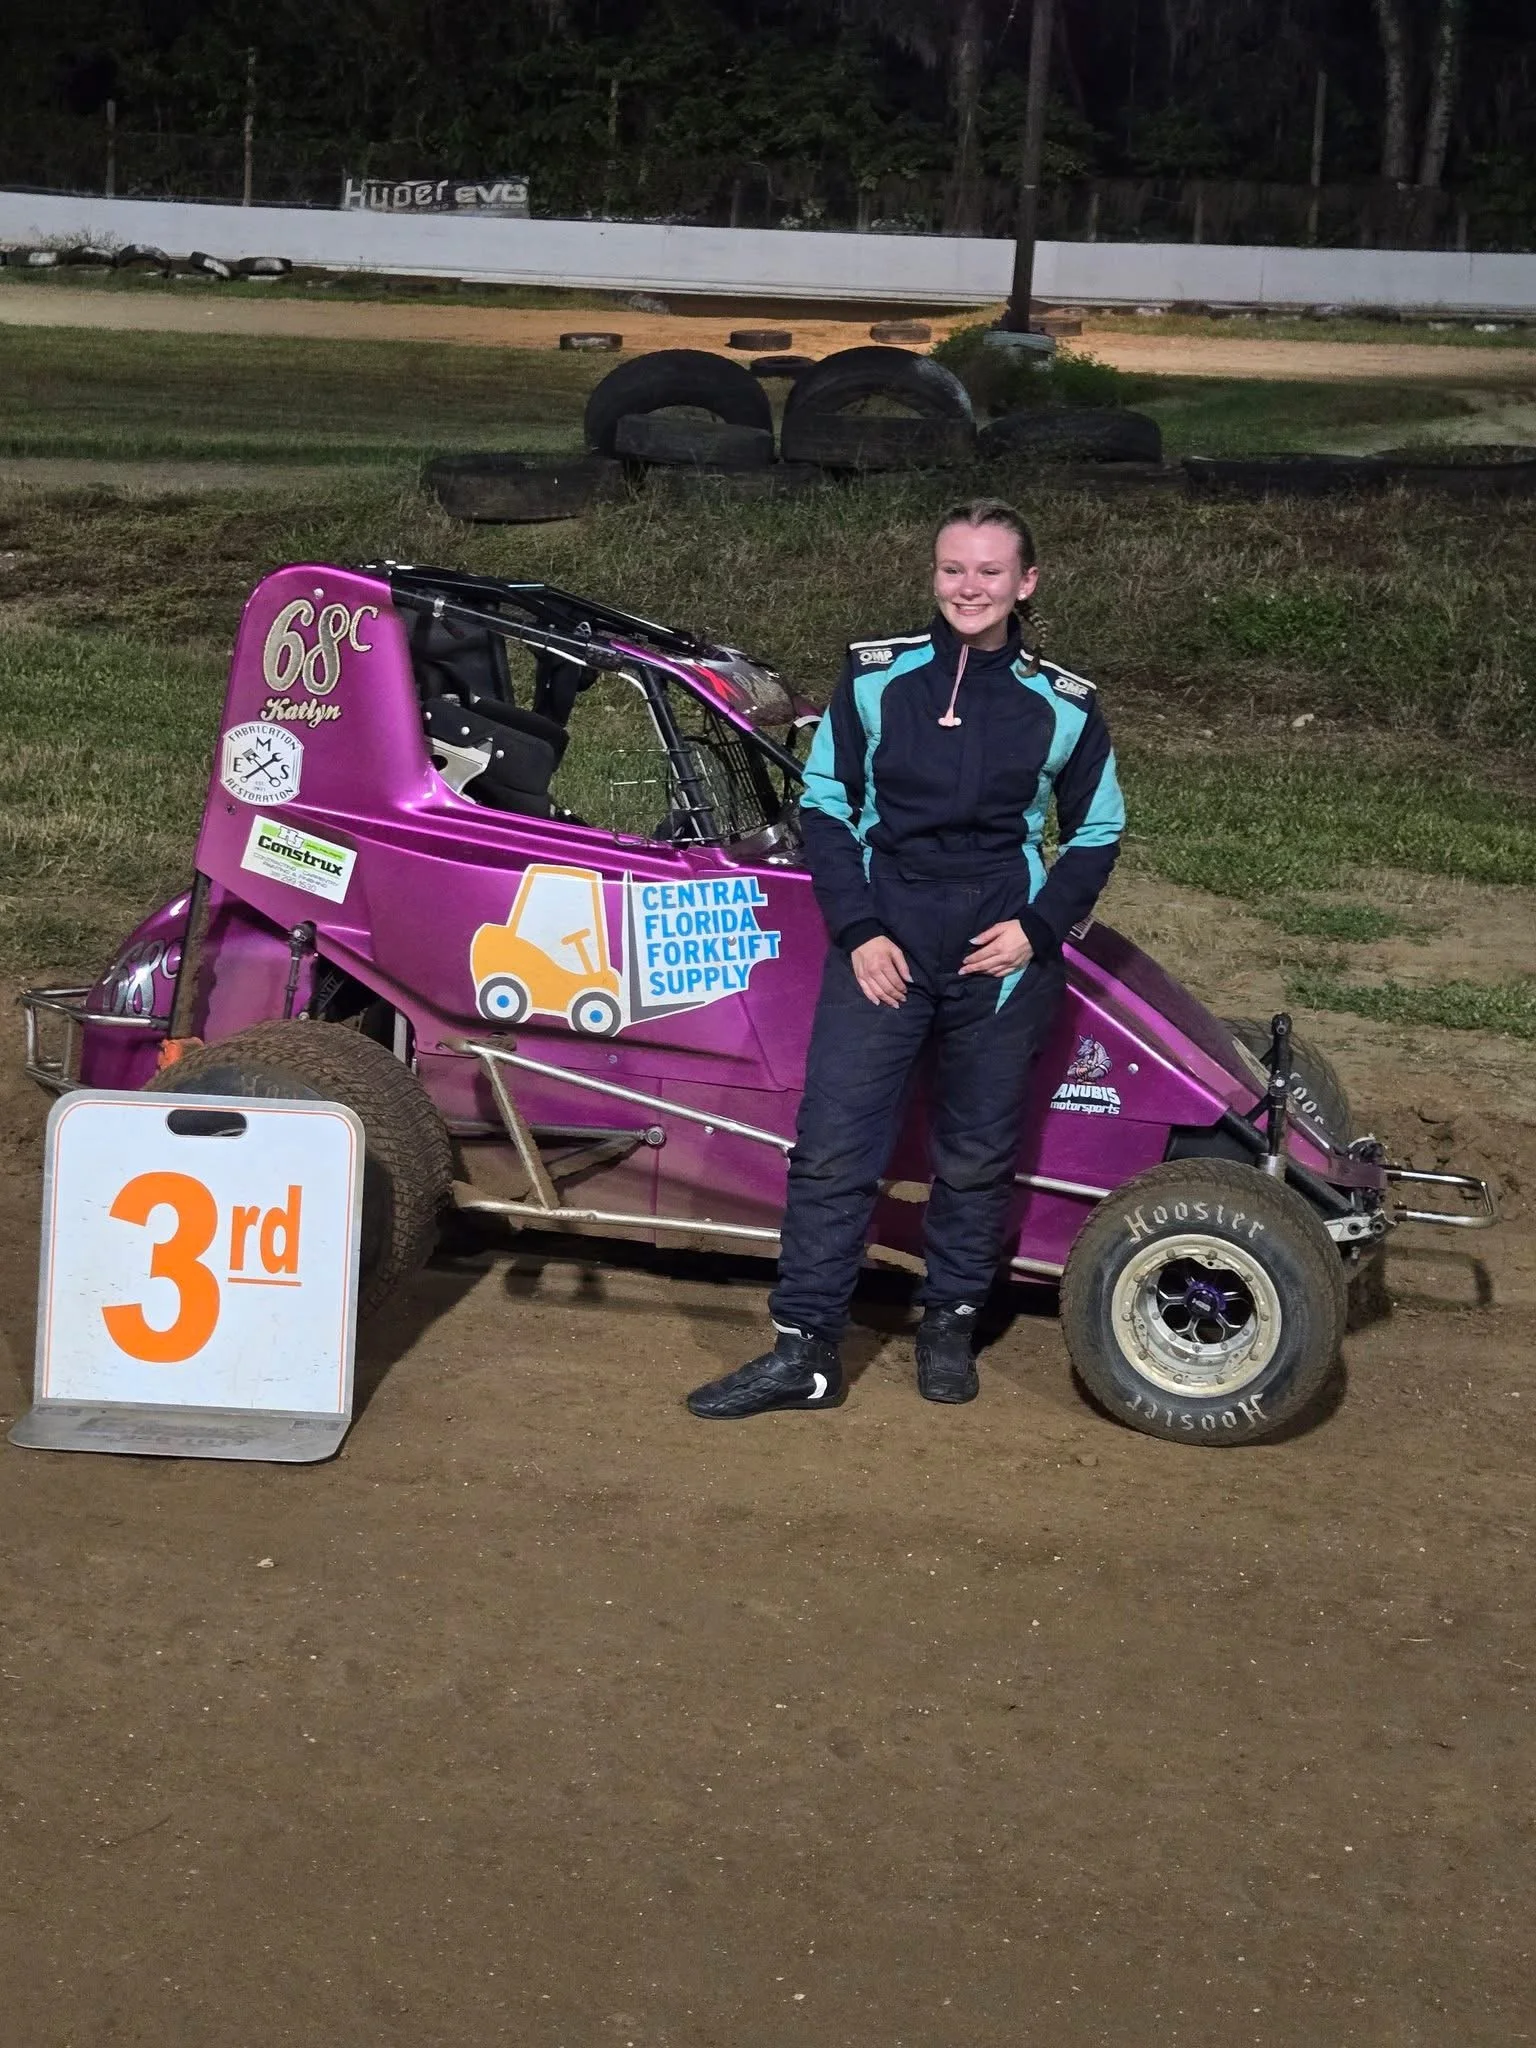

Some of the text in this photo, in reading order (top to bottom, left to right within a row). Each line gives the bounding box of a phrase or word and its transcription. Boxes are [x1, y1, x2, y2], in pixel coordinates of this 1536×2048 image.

[263, 599, 379, 696] 68C
[859, 649, 893, 664] OMP
[1054, 677, 1088, 697] OMP
[228, 725, 298, 751] FABRICATION
[225, 777, 295, 803] RESTORATION
[258, 834, 343, 877] Construx
[642, 879, 765, 911] CENTRAL
[644, 907, 757, 939] FLORIDA
[647, 934, 779, 967] FORKLIFT
[650, 964, 749, 996] SUPPLY
[1050, 1100, 1121, 1115] motorsports
[1052, 1083, 1121, 1105] ANUBIS
[102, 1171, 302, 1363] 3rd
